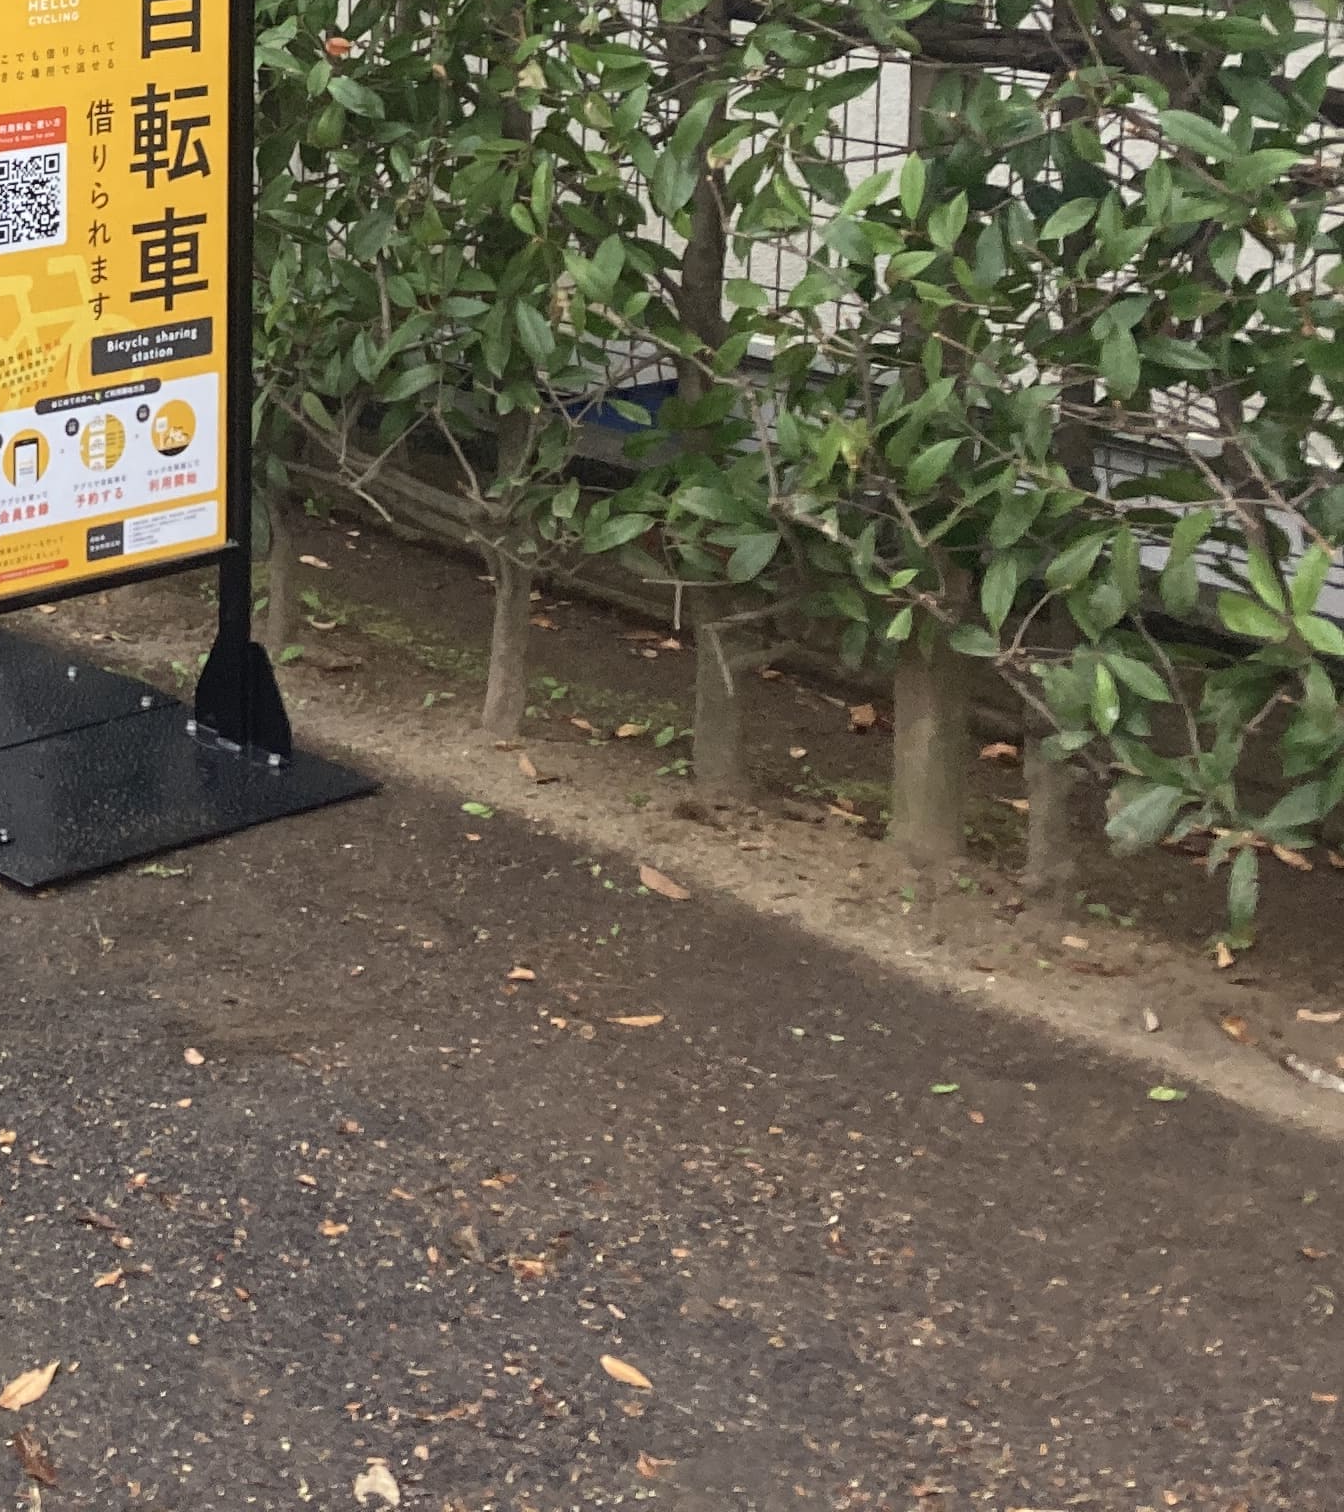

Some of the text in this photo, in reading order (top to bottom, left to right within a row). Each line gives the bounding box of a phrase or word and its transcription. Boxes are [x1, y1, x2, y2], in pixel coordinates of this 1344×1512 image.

[27, 10, 80, 27] CYCLING
[86, 97, 116, 321] 借りられます
[107, 326, 198, 354] Bicycle sharing
[131, 345, 174, 364] station
[75, 487, 124, 508] 予約する
[0, 502, 49, 525] 会員登録
